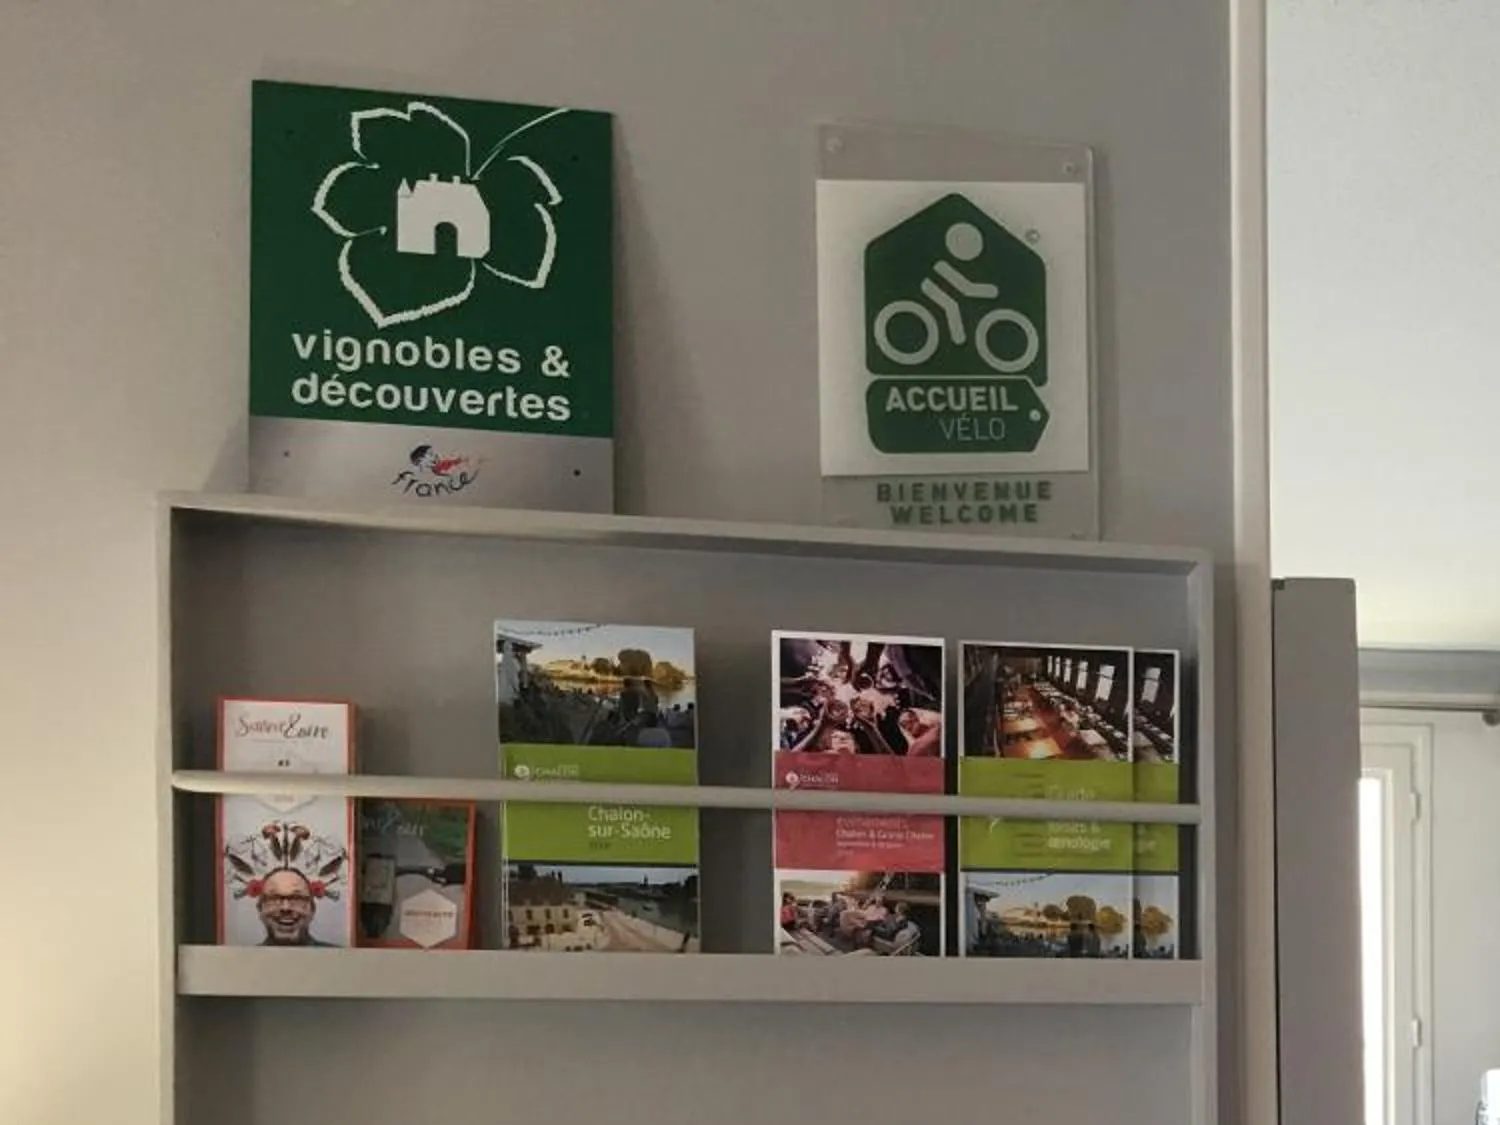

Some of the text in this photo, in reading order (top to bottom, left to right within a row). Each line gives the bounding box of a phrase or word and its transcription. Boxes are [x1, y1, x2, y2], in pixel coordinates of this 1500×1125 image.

[291, 330, 571, 378] vignobles &
[291, 373, 572, 421] découvertes
[885, 386, 1019, 412] ACCUEIL
[939, 413, 1006, 441] VÉLO
[876, 480, 1054, 503] BIENVENUE
[890, 502, 1039, 525] WELCOME
[588, 822, 672, 840] sur-Saône
